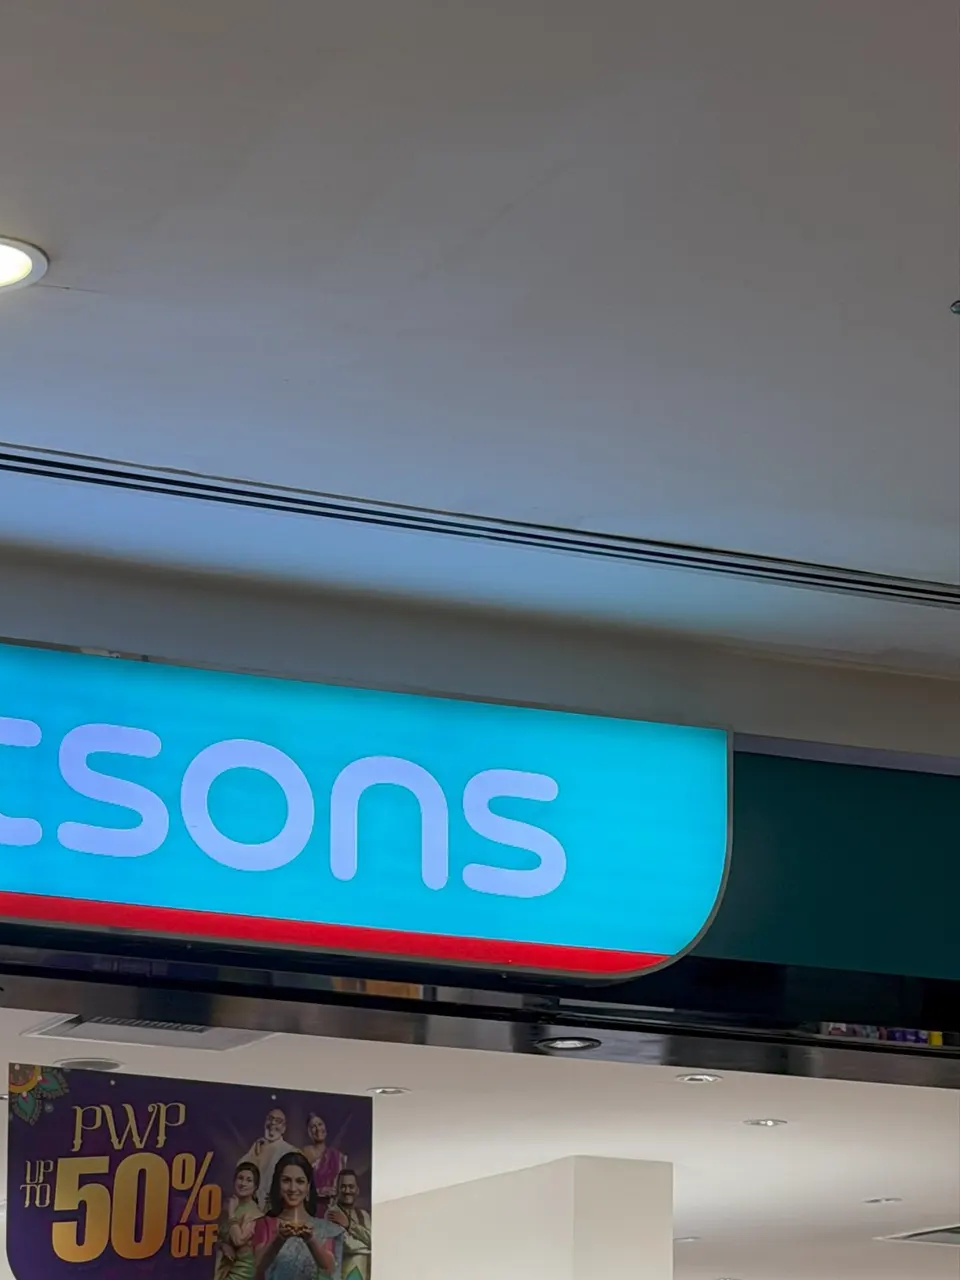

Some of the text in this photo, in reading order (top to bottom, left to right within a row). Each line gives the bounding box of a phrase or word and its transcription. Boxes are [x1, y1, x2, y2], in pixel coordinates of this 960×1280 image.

[71, 1102, 186, 1152] PWP
[25, 1160, 53, 1184] UP
[20, 1184, 51, 1208] TO
[51, 1151, 222, 1263] 50%
[171, 1224, 218, 1258] OFF
